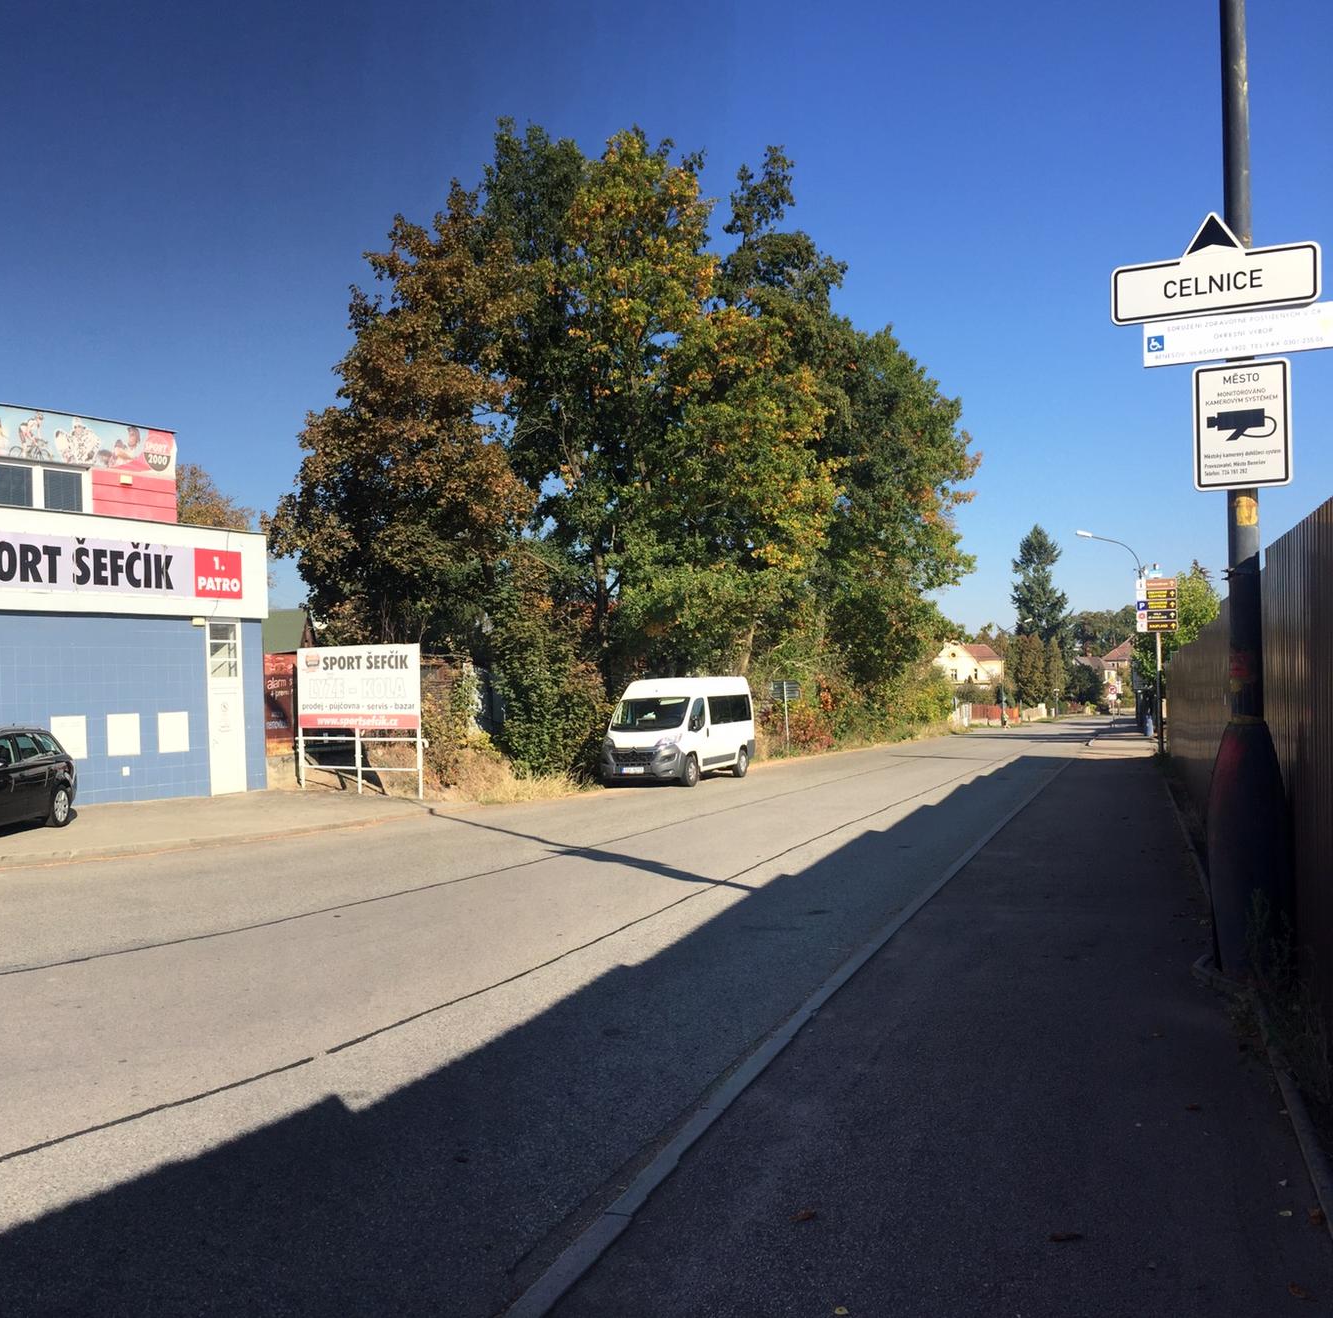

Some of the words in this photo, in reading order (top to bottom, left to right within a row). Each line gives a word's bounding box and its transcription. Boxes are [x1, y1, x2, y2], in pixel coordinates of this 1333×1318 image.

[1163, 268, 1263, 299] CELNICE
[1222, 372, 1260, 385] MĚSTO
[147, 453, 168, 466] 2000
[72, 537, 174, 590] ŠEFČÍK
[212, 556, 226, 570] 1.
[197, 576, 241, 593] PATRO
[322, 655, 362, 671] SPORT
[366, 650, 409, 670] ŠEFČÍK
[267, 677, 287, 690] alarm
[309, 673, 345, 699] LYŽE
[361, 676, 406, 700] KOLA
[301, 703, 324, 711] prodej
[366, 702, 389, 710] servis
[394, 702, 415, 710] bazar
